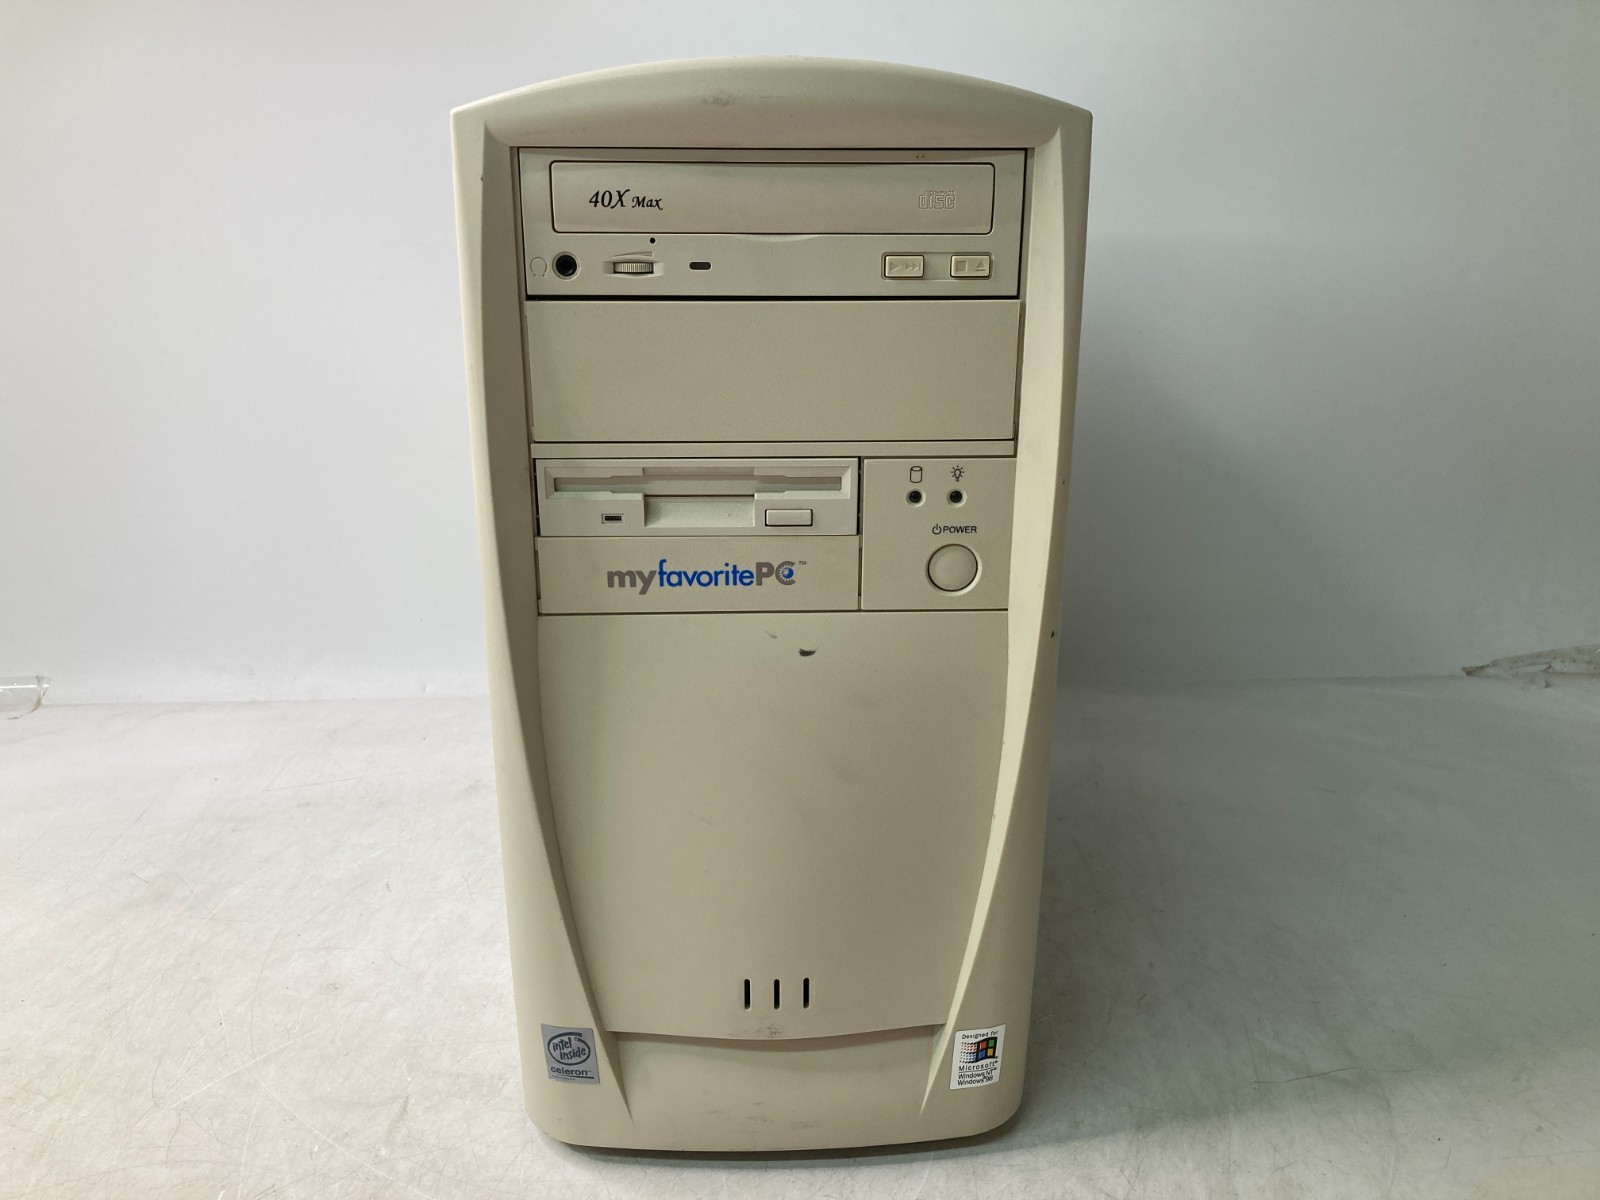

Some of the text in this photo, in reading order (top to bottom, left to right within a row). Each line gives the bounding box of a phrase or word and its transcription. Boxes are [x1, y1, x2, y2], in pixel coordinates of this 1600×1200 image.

[588, 189, 663, 210] 40X Max
[943, 525, 977, 534] POWER
[552, 1037, 572, 1051] intel
[560, 1047, 586, 1060] inside
[550, 1066, 588, 1076] celeron
